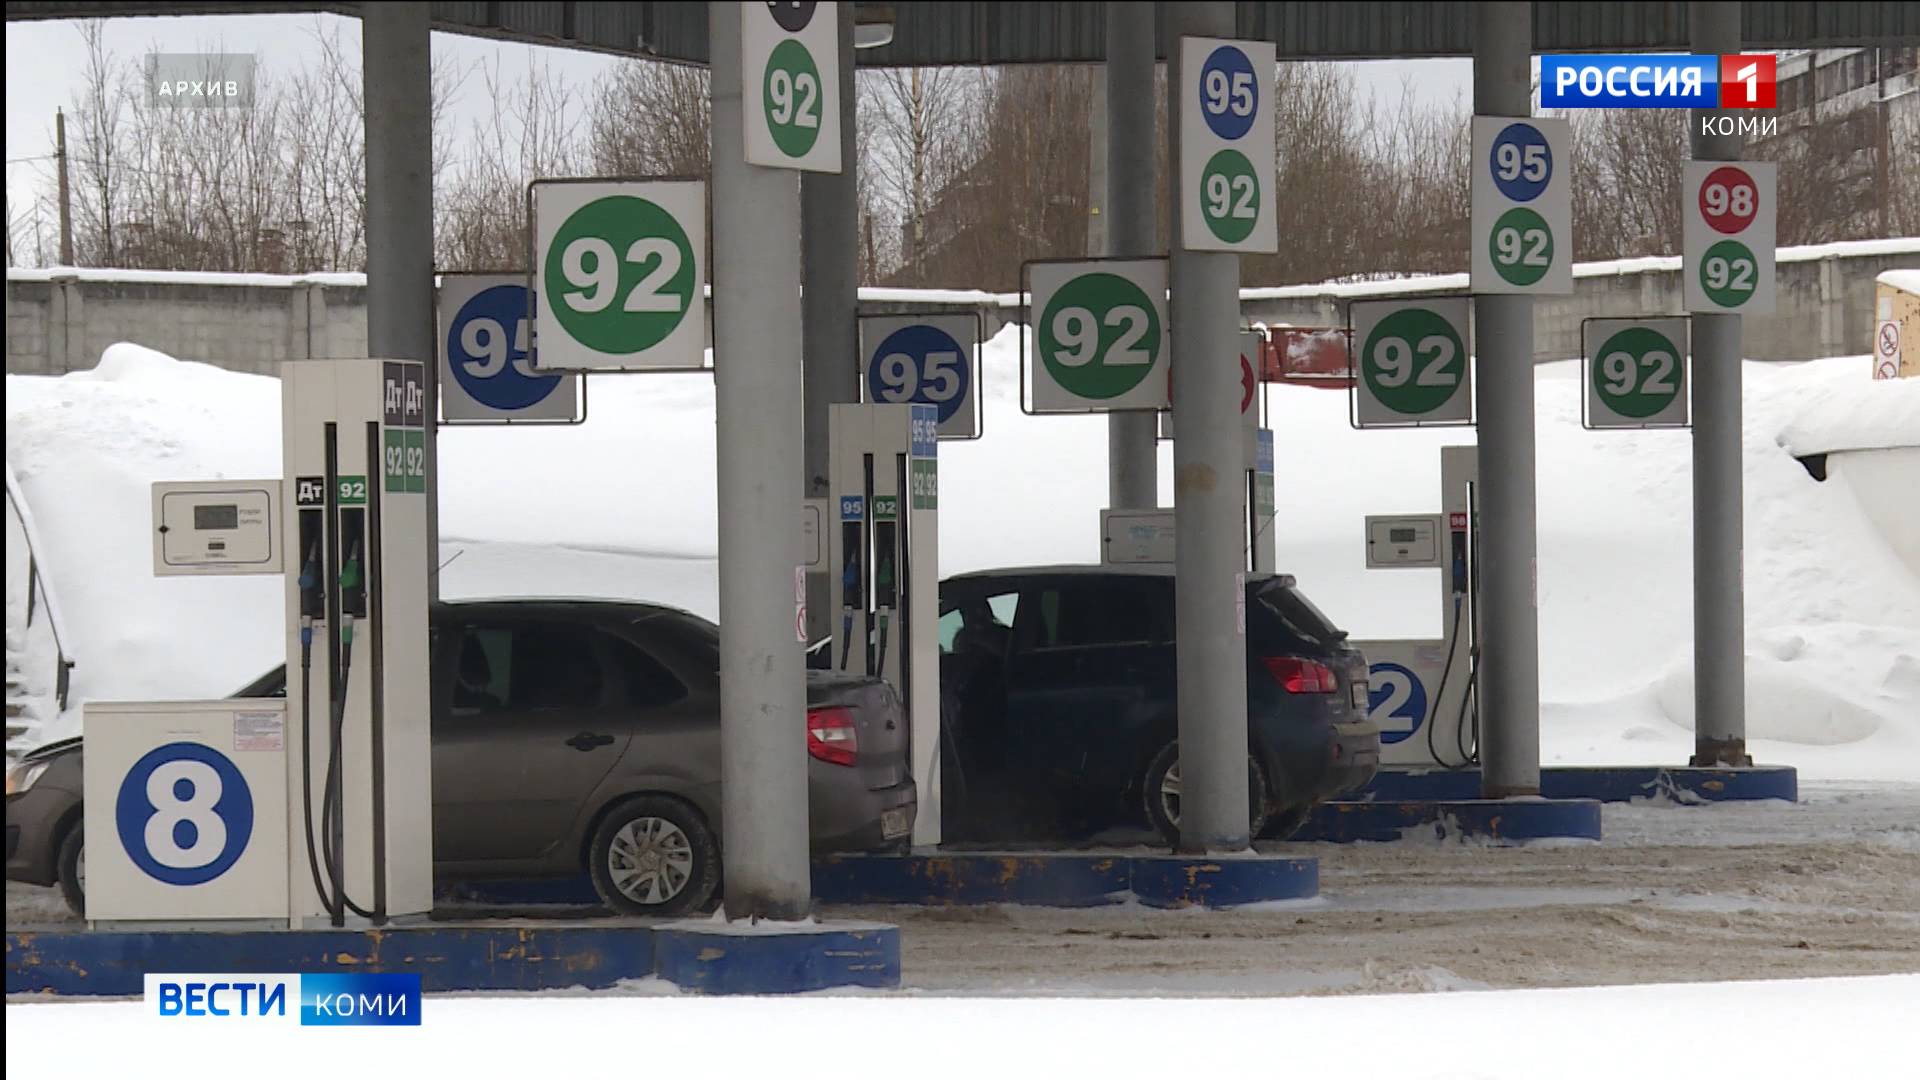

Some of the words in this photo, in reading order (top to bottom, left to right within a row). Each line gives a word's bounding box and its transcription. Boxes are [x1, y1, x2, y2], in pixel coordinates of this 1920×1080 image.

[770, 69, 818, 128] 92
[1206, 69, 1253, 116] 95
[1496, 143, 1546, 182] 95
[1207, 173, 1256, 218] 92
[1704, 183, 1755, 216] 98
[1497, 227, 1548, 266] 92
[561, 237, 682, 312] 92
[1705, 257, 1754, 291] 92
[1052, 305, 1150, 366] 92
[879, 351, 961, 403] 95
[1373, 335, 1457, 388] 92
[1602, 351, 1676, 396] 92
[912, 420, 923, 442] 95
[926, 420, 937, 443] 95
[386, 447, 403, 476] 92
[407, 447, 424, 476] 92
[299, 482, 323, 502] Дт
[340, 483, 365, 498] 92
[842, 501, 862, 514] 95
[876, 501, 896, 513] 92
[1368, 671, 1413, 730] 2
[144, 759, 227, 869] 8
